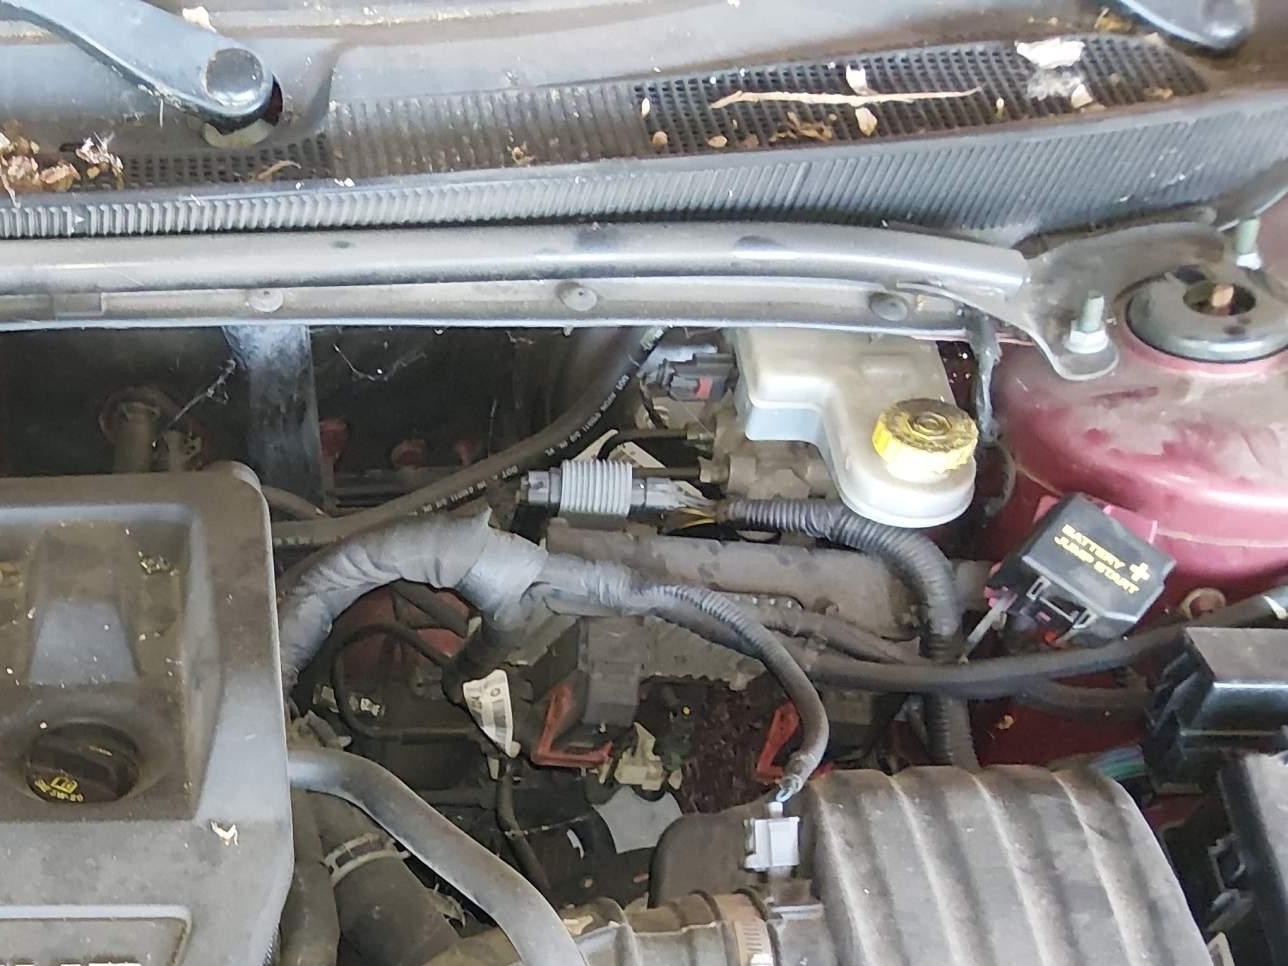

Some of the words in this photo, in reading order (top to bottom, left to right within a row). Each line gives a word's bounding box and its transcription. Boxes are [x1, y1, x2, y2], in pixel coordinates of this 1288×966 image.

[1053, 536, 1095, 564] JUMP
[1093, 560, 1140, 594] START
[1061, 523, 1126, 570] BATTERY
